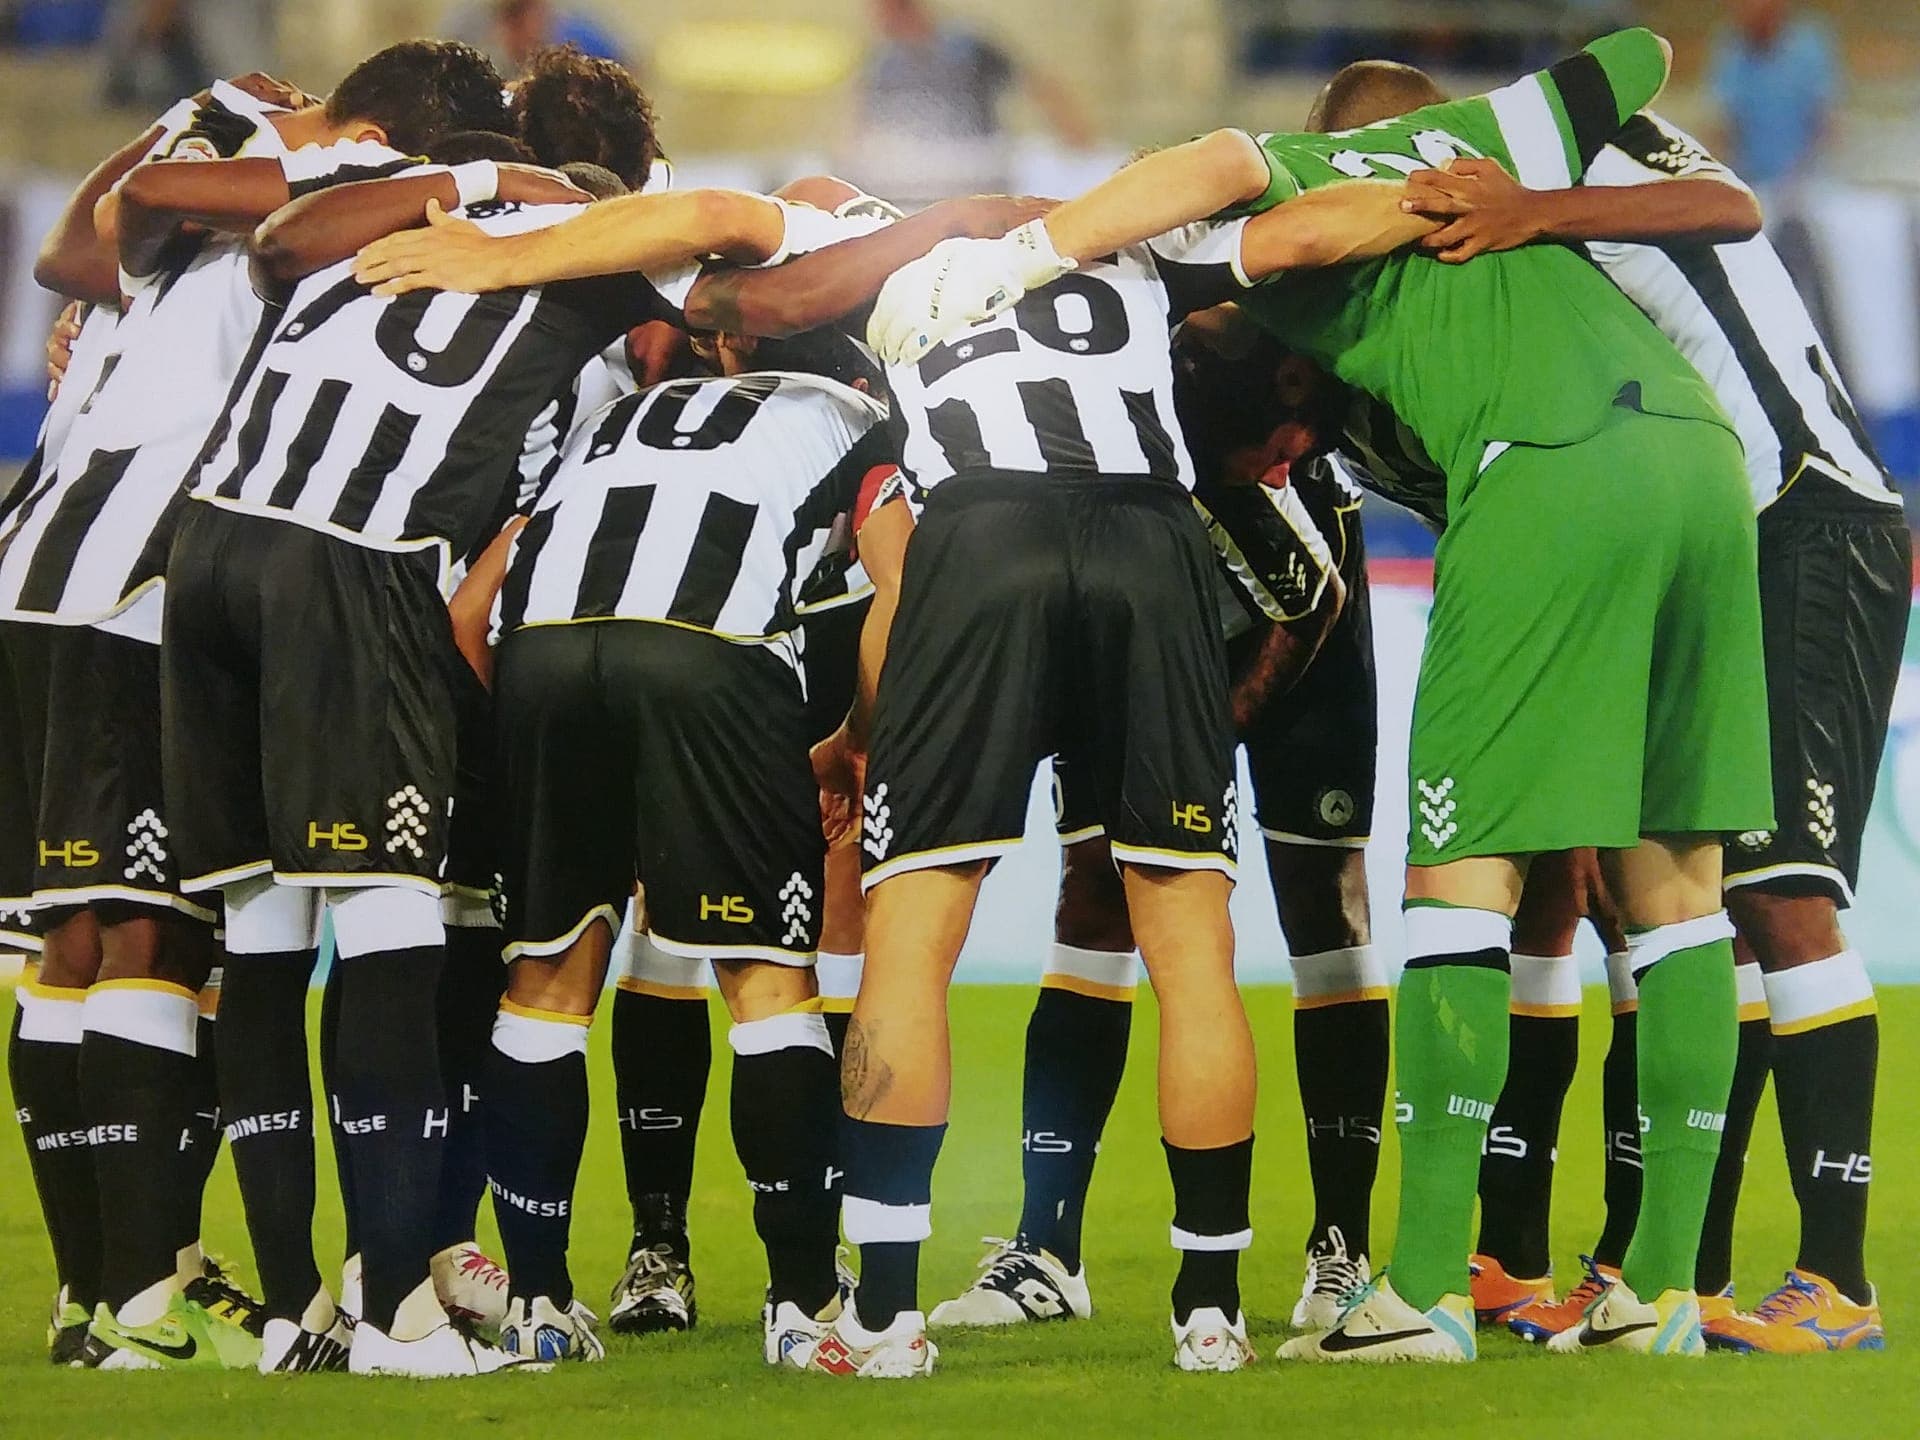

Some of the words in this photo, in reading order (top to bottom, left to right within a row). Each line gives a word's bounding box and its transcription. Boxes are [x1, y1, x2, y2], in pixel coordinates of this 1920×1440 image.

[1172, 800, 1212, 833] HS
[307, 822, 369, 851] HS
[39, 840, 100, 867] HS
[699, 895, 755, 923] HS
